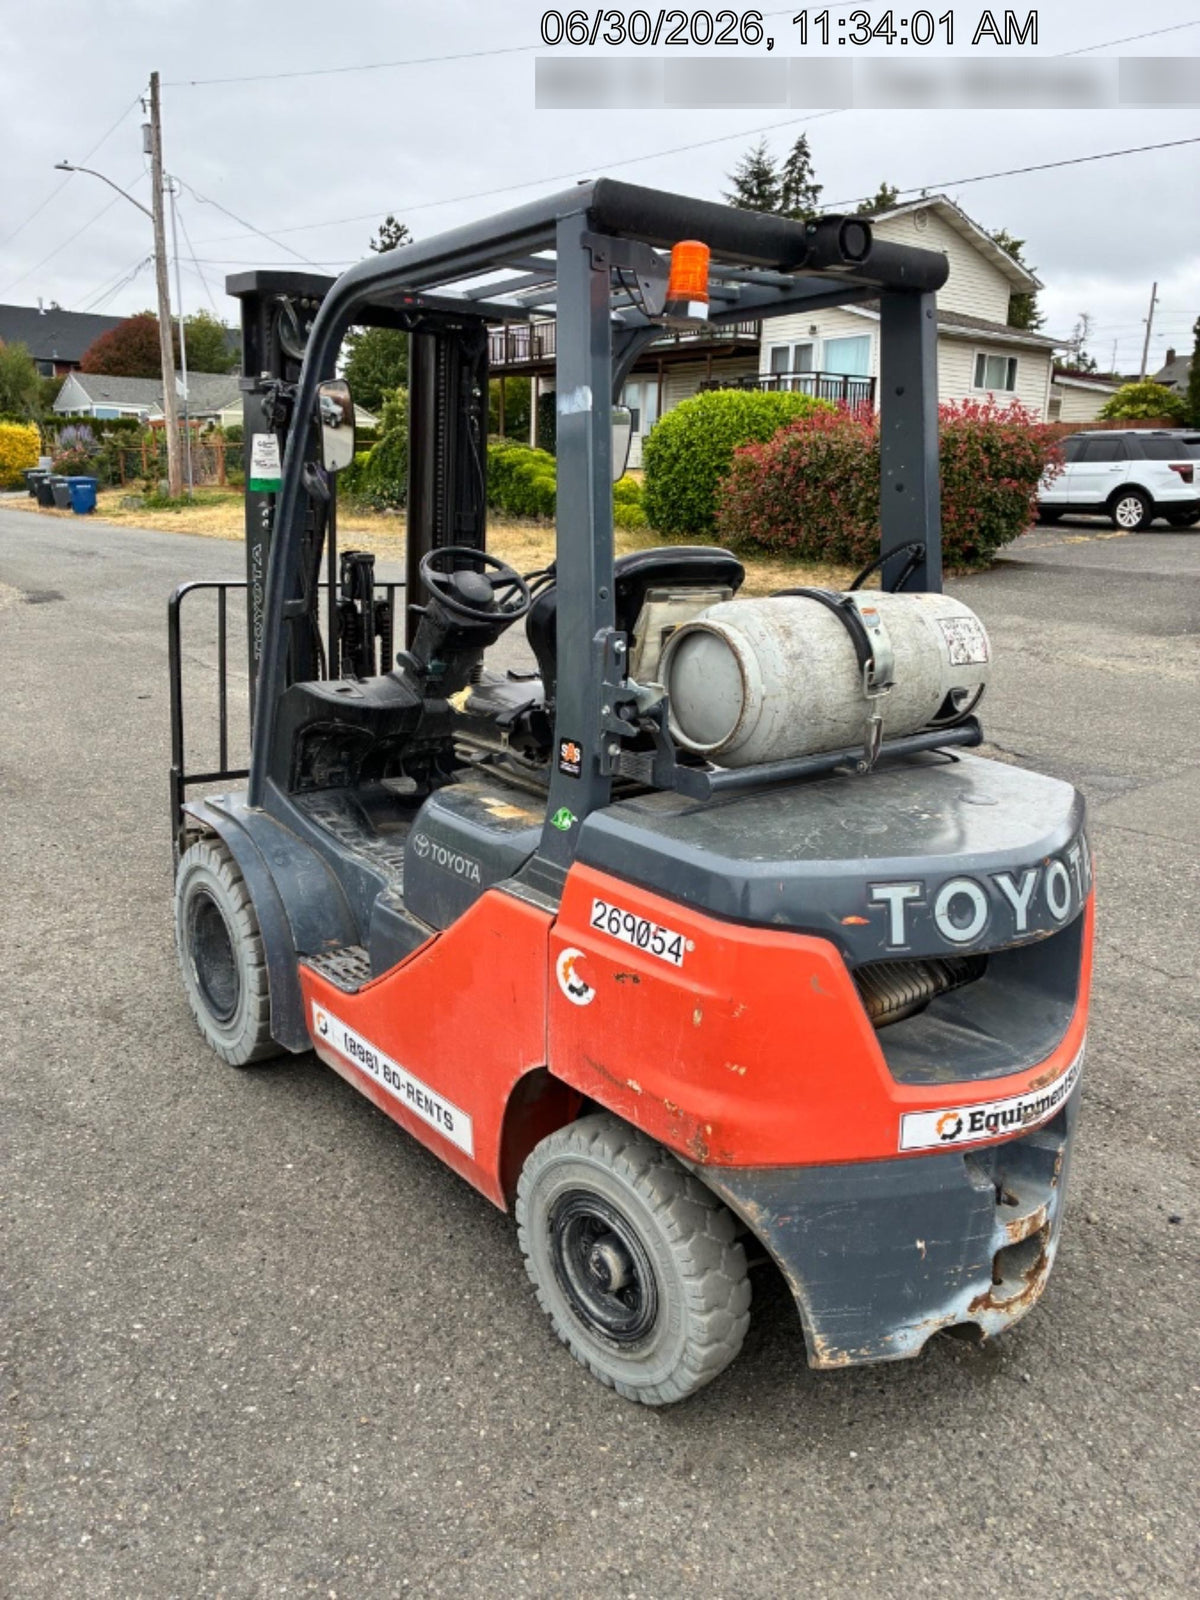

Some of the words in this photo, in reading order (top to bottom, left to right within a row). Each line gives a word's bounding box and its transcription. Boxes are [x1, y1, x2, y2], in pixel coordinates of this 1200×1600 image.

[431, 843, 481, 884] TOYOTA
[592, 901, 682, 963] 269054
[344, 1032, 379, 1075] (888)
